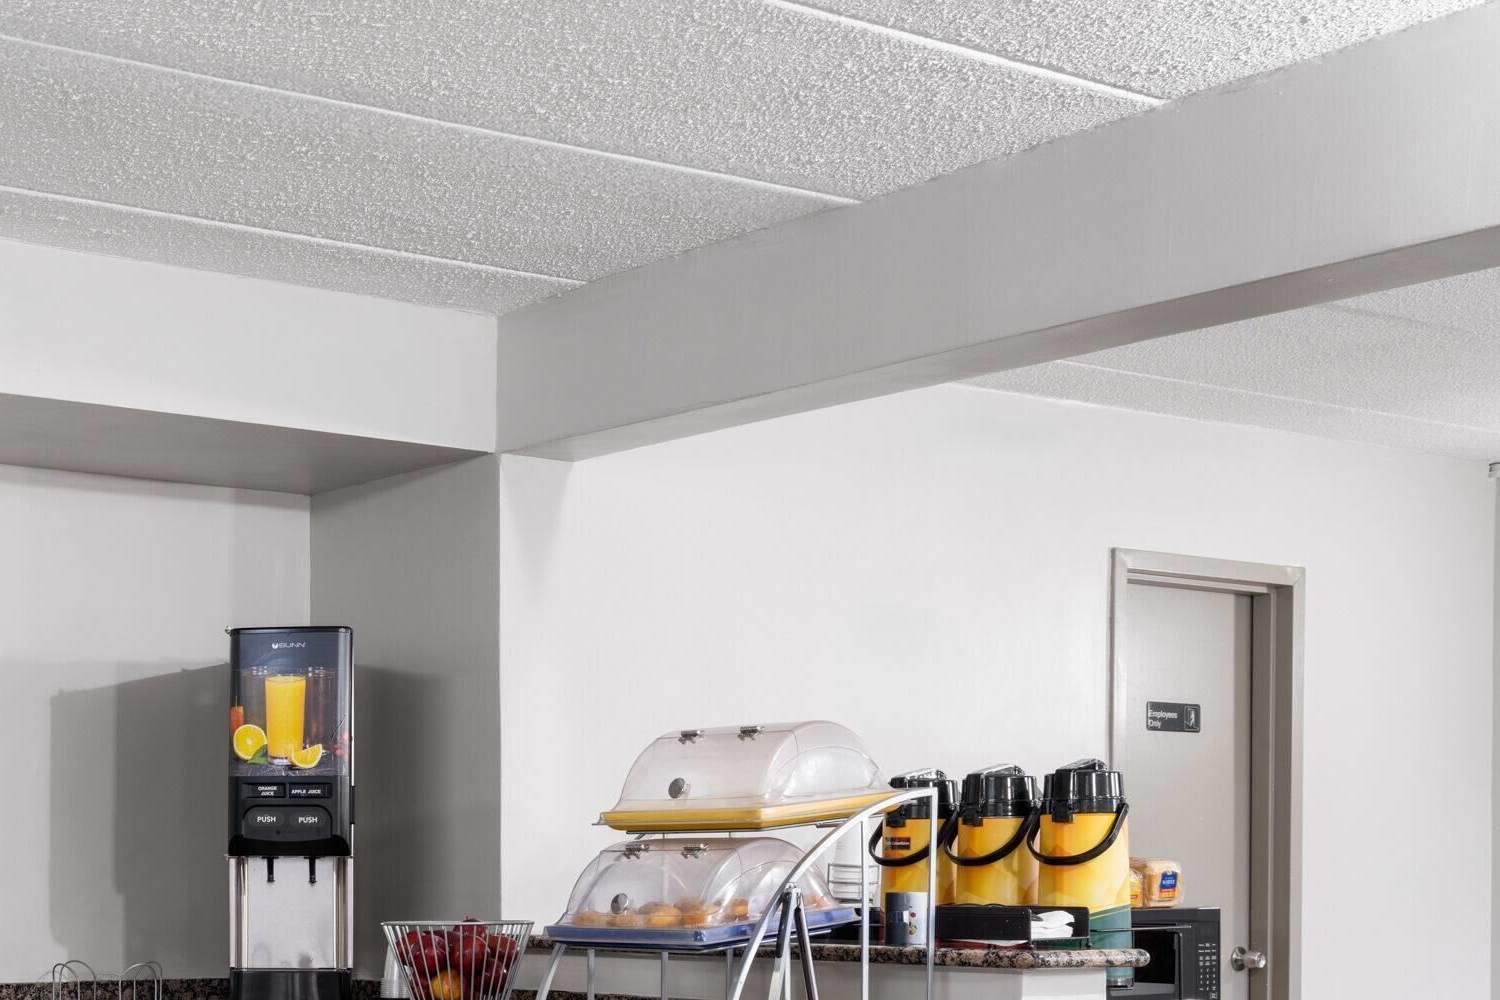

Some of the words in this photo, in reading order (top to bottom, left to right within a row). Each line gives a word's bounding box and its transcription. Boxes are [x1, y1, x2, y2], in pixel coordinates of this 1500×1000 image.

[1148, 710, 1177, 720] Employees
[1148, 719, 1162, 729] Only
[298, 816, 318, 824] PUSH
